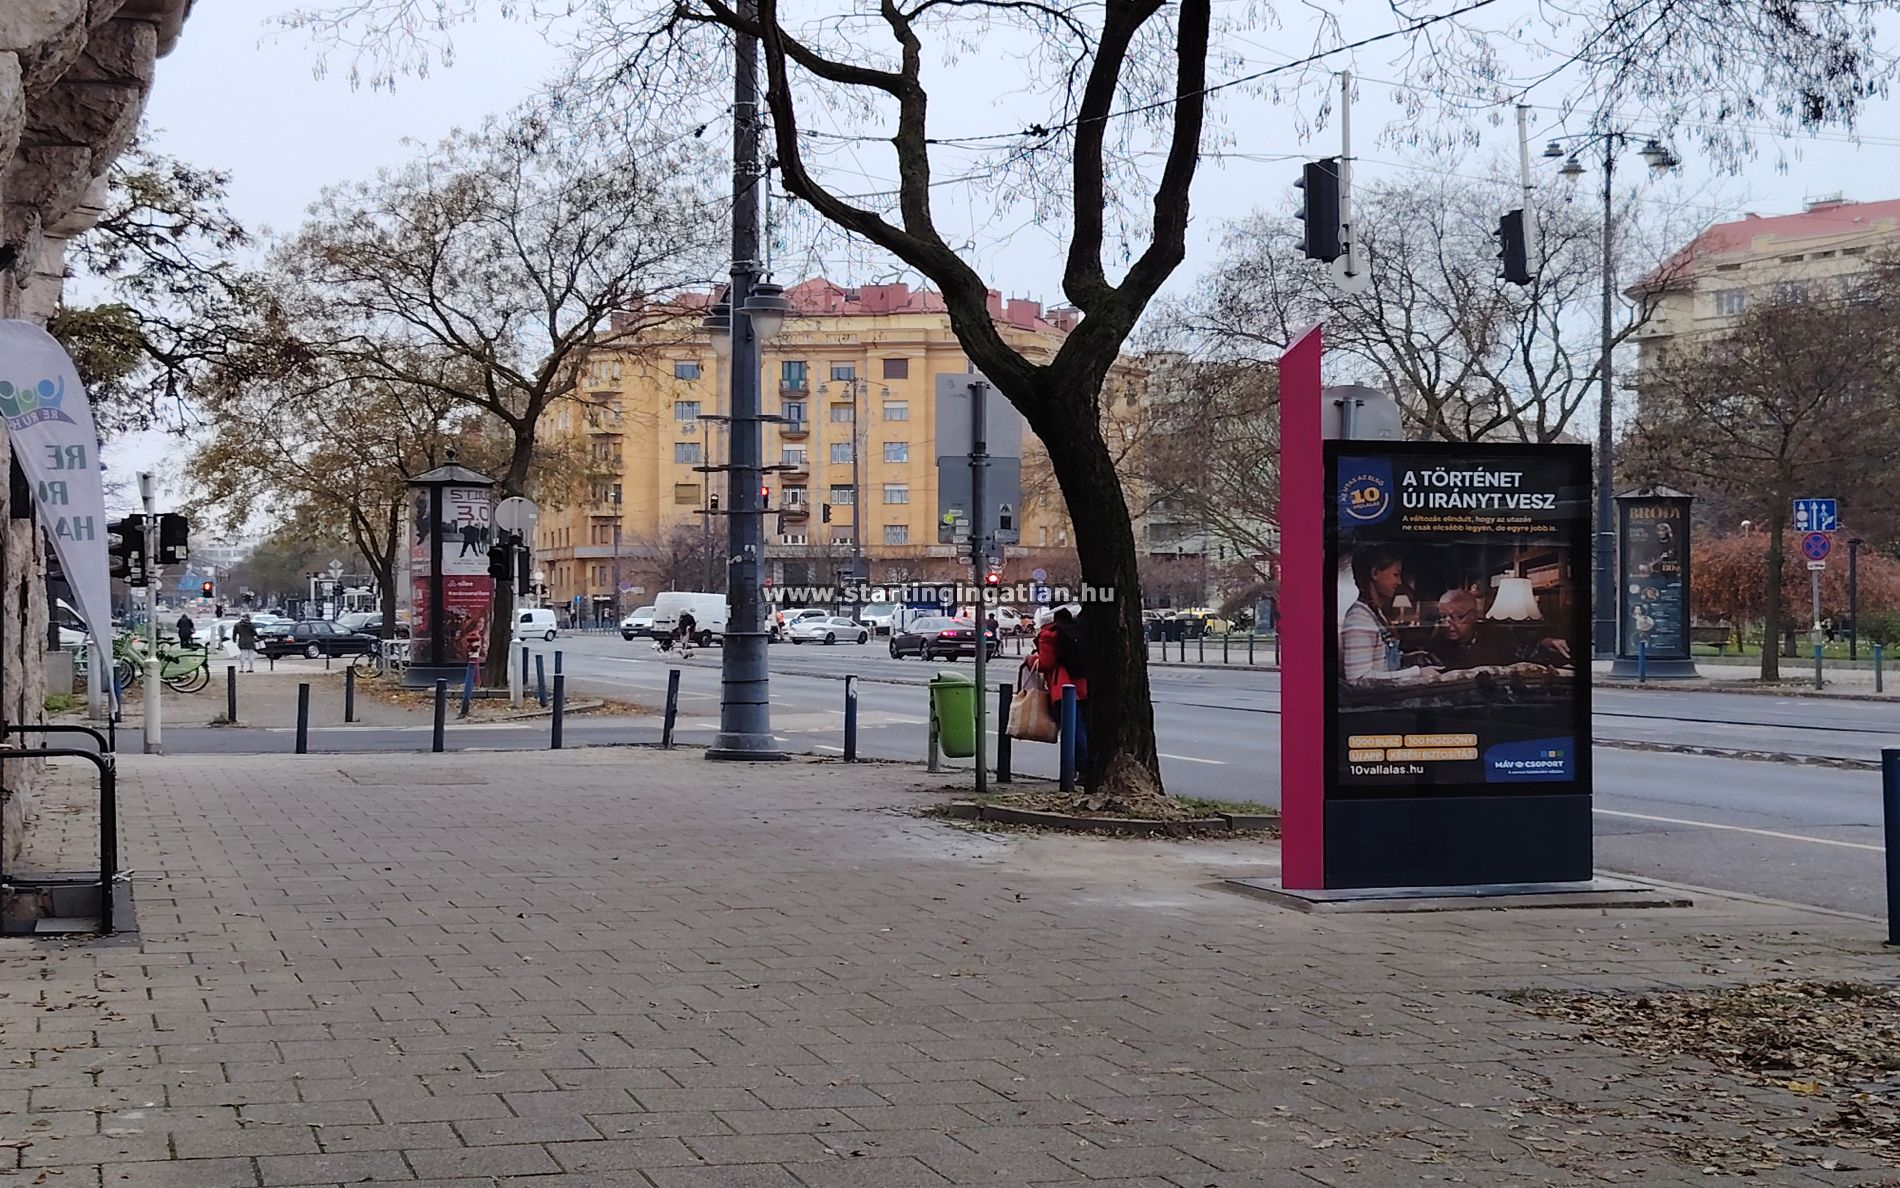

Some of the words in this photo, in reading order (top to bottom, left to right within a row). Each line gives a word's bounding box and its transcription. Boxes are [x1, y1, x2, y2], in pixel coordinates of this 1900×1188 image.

[1402, 471, 1417, 487] A
[1421, 466, 1523, 487] TÖRTÉNET
[1350, 486, 1380, 505] 10
[1402, 488, 1426, 508] ÚJ
[1430, 487, 1502, 509] IRÁNYT
[1506, 493, 1556, 509] VESZ
[1475, 515, 1495, 524] hogy
[1507, 515, 1532, 523] utazás
[1530, 525, 1548, 533] jobb
[1350, 764, 1424, 775] 10vallalas.hu
[1494, 760, 1514, 768] MÁV
